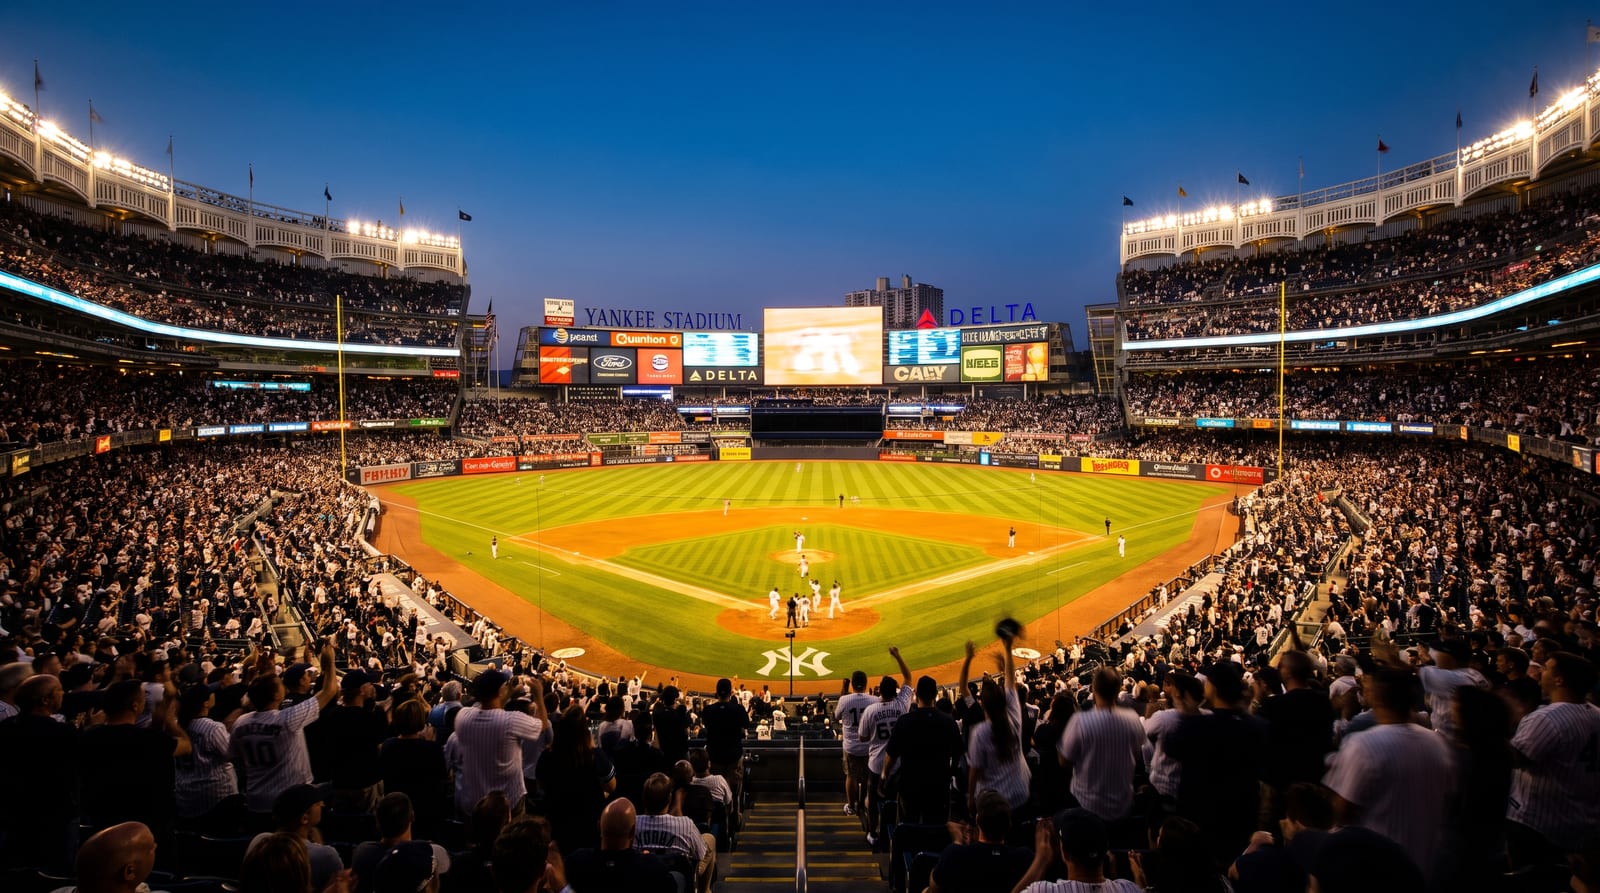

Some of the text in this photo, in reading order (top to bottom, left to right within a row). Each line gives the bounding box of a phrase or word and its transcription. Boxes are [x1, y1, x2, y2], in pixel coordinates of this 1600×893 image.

[584, 308, 741, 330] YANKEE STADIUM
[949, 303, 1036, 326] DELTA
[705, 370, 757, 381] DELTA
[244, 741, 276, 767] 10
